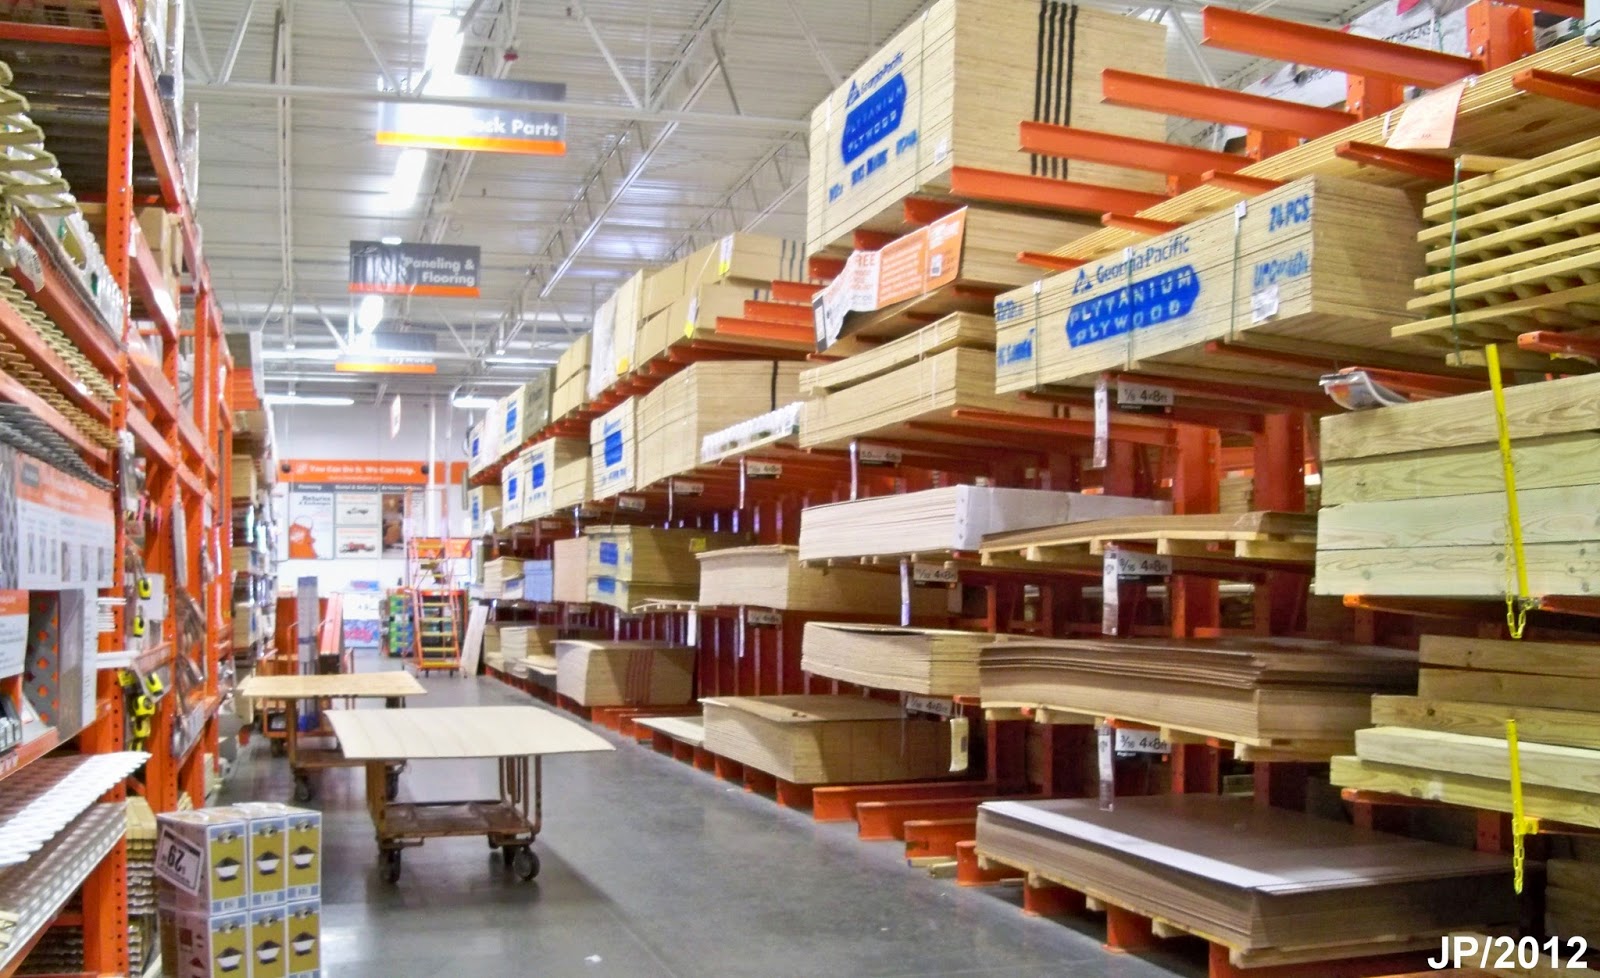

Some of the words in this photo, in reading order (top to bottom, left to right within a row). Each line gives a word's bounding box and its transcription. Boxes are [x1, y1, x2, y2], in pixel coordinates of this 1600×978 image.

[511, 119, 558, 136] Parts
[403, 256, 460, 272] Paneling
[464, 258, 474, 270] &
[422, 271, 475, 287] Flooring
[1069, 269, 1193, 327] PLYTANIUM
[1073, 299, 1181, 346] PLYWOOD
